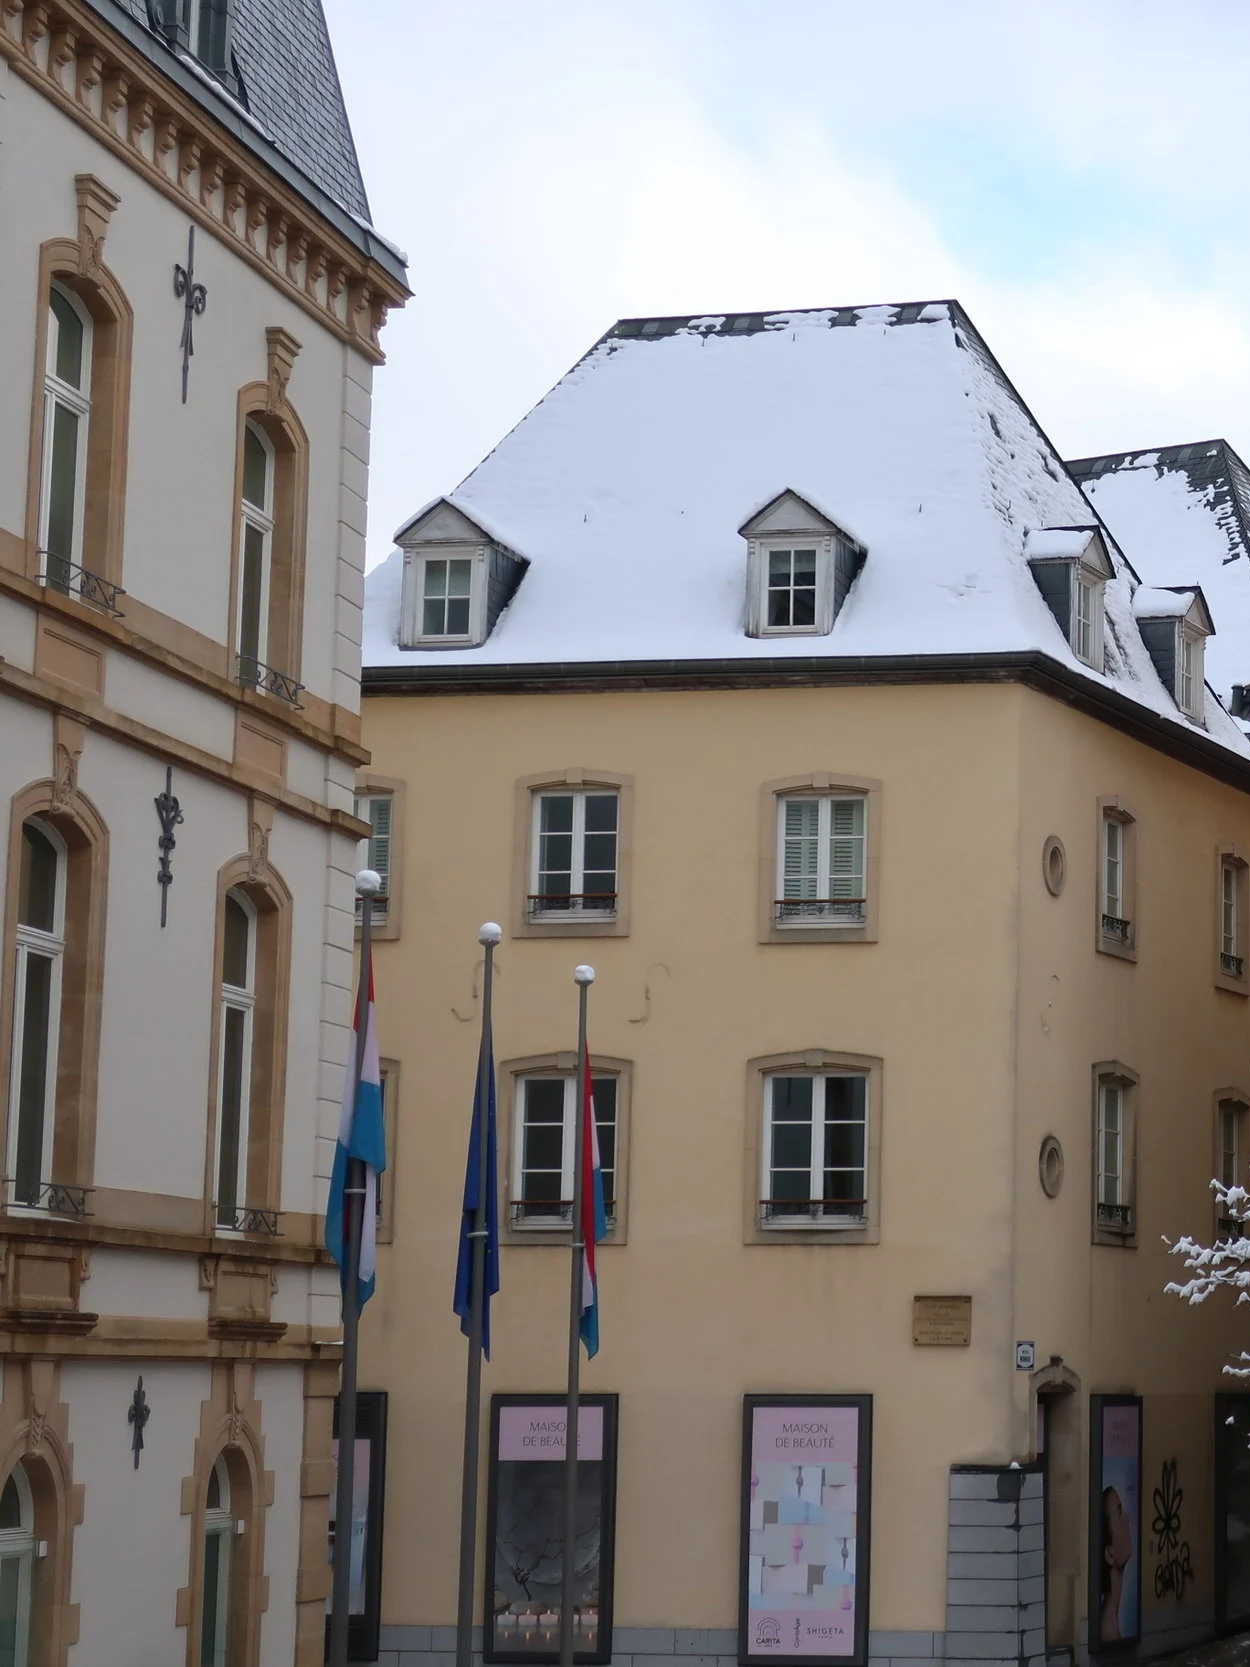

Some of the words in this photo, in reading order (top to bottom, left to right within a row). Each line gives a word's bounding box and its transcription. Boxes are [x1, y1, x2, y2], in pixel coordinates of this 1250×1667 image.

[529, 1421, 567, 1433] MAISO
[782, 1423, 829, 1434] MAISON
[522, 1436, 537, 1447] DE
[775, 1437, 790, 1448] DE
[792, 1435, 835, 1449] BEAUTÉ
[806, 1627, 844, 1635] SHIGETA
